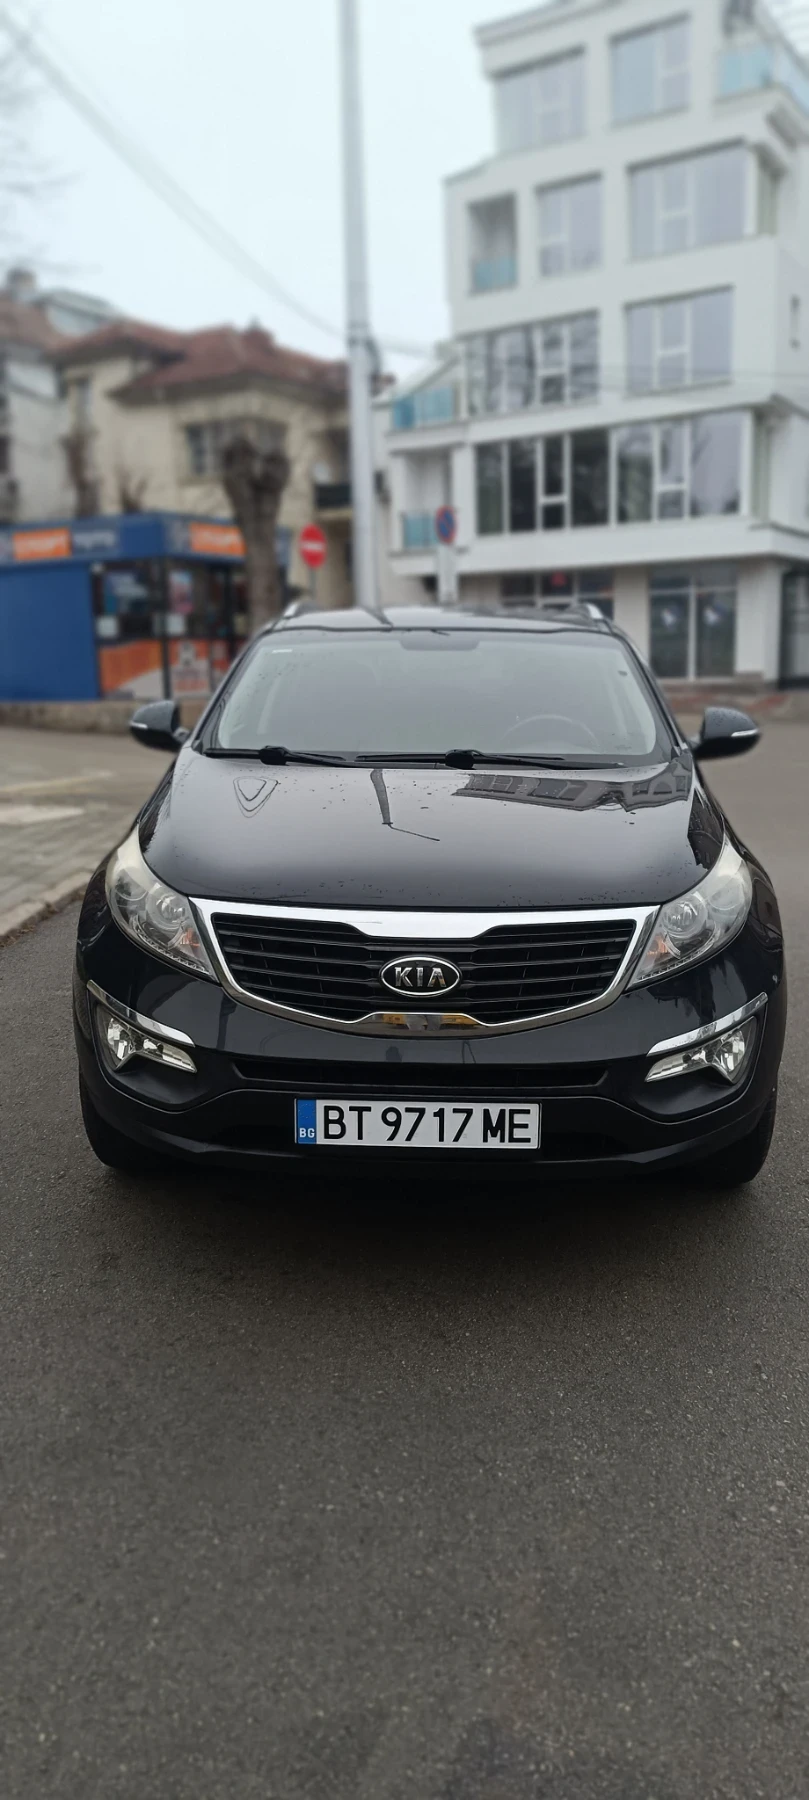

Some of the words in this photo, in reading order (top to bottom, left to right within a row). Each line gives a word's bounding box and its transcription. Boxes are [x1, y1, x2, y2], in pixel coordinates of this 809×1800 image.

[394, 967, 447, 988] KIA
[299, 1127, 315, 1139] BG
[323, 1105, 372, 1141] BT
[381, 1106, 474, 1143] 9717
[482, 1108, 531, 1143] ME
